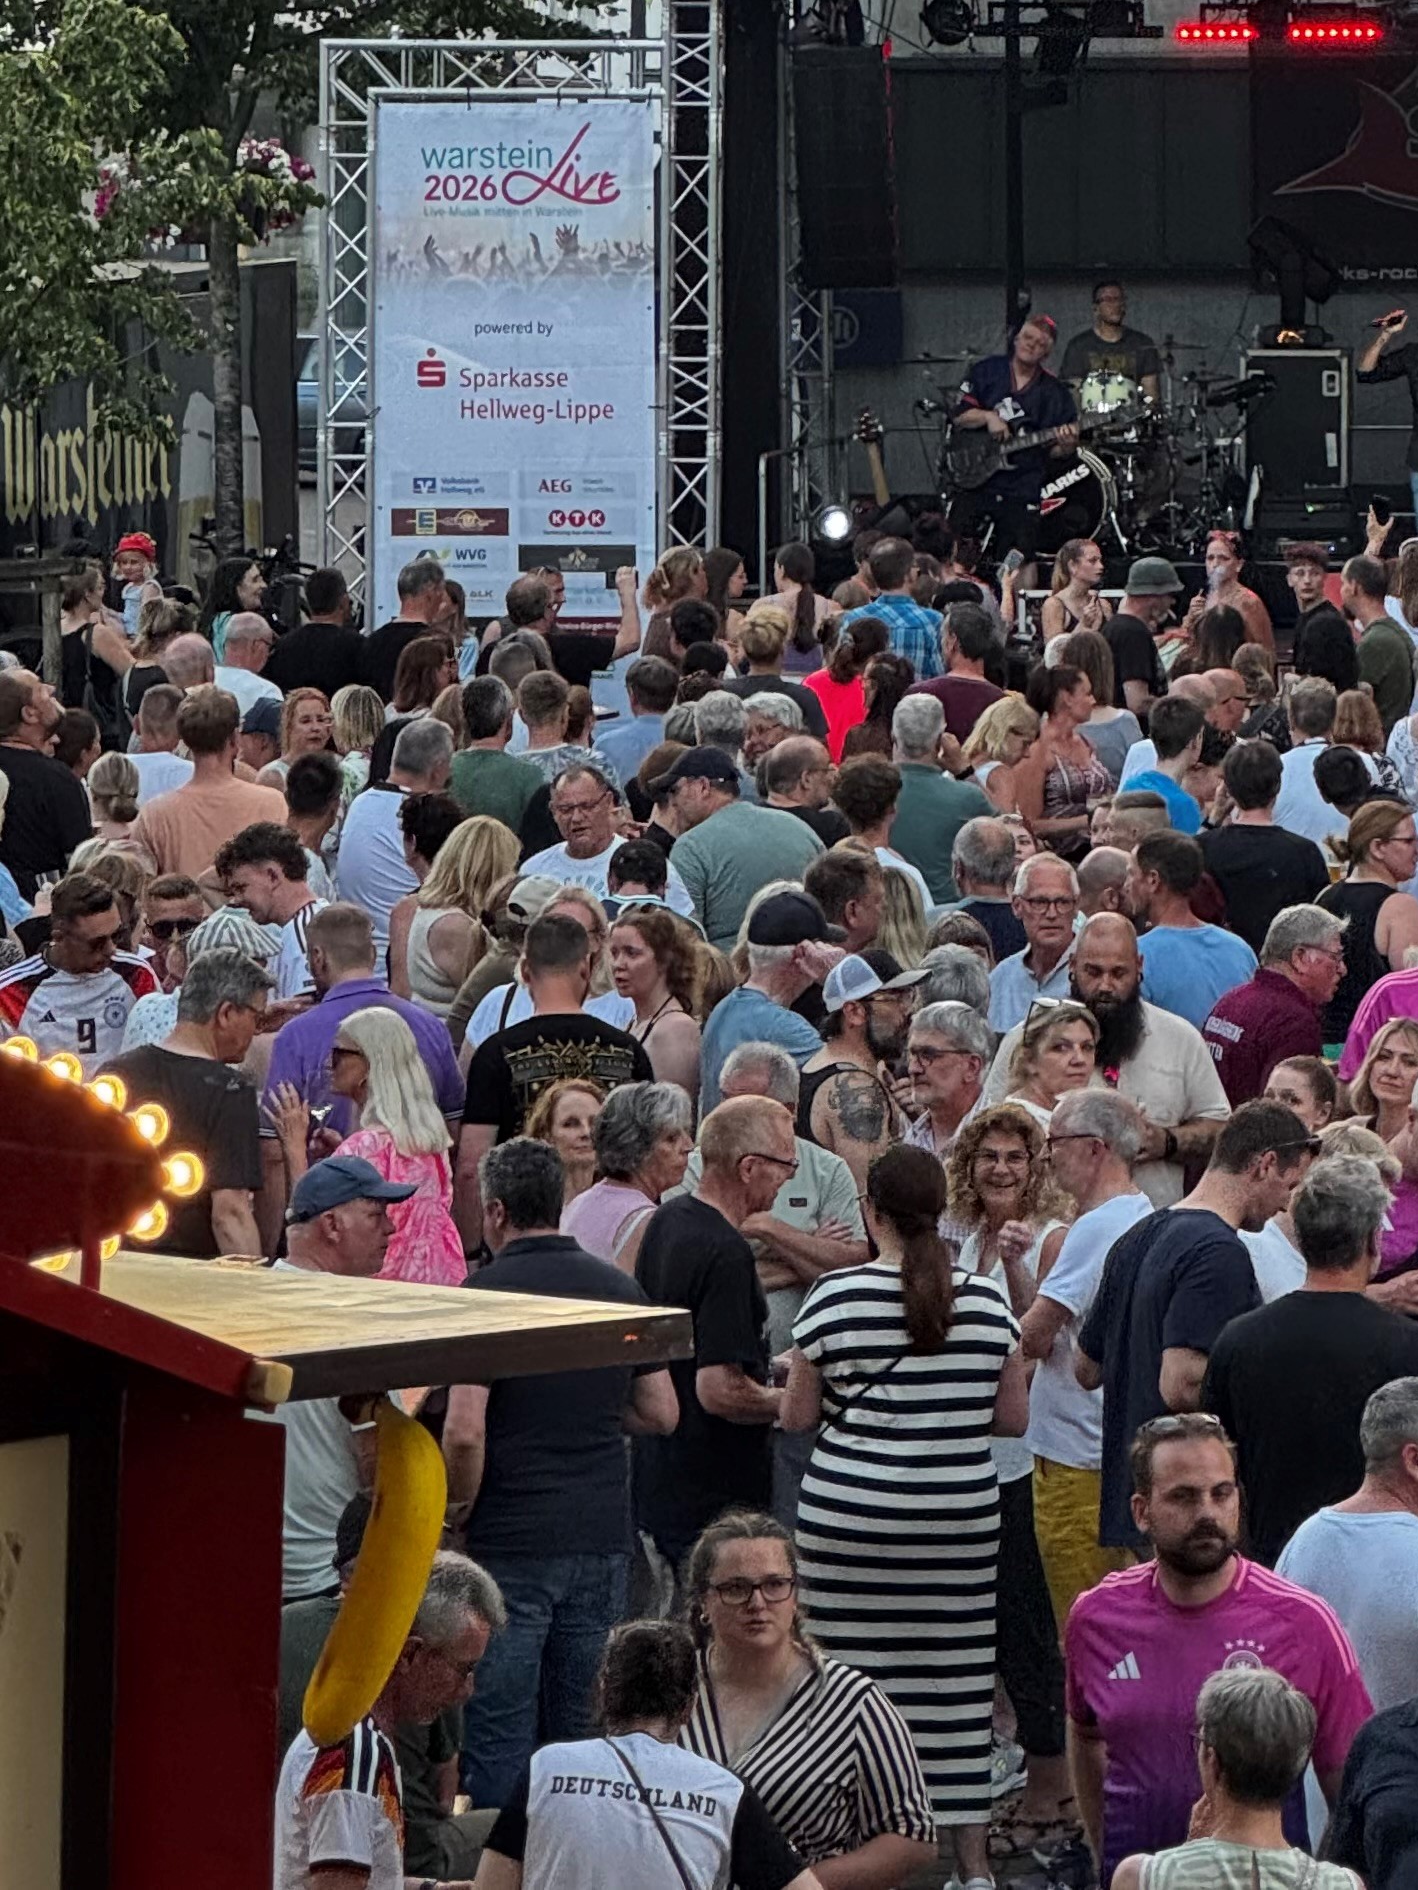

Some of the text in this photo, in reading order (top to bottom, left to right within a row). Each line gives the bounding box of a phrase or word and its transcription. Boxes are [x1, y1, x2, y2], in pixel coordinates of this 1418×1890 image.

[421, 139, 552, 169] warstein
[424, 174, 498, 201] 2026
[474, 321, 554, 336] powered by
[459, 367, 569, 392] Sparkasse
[460, 398, 615, 425] Hellweg-Lippe
[538, 479, 572, 493] AEG
[455, 549, 487, 561] WVG
[77, 1017, 97, 1054] 9
